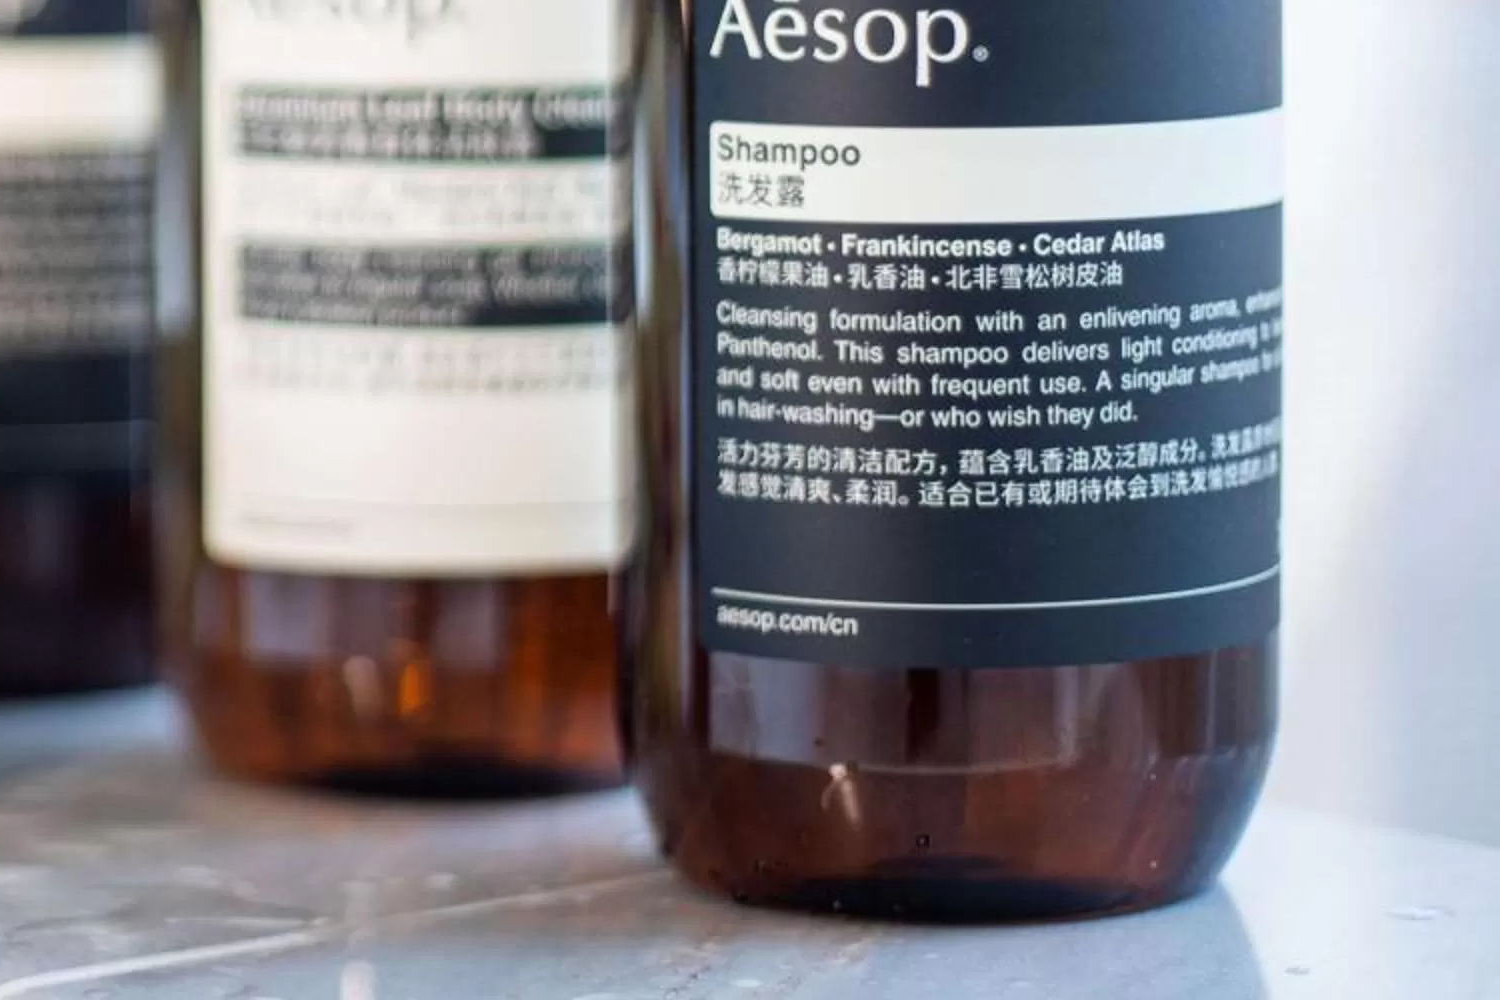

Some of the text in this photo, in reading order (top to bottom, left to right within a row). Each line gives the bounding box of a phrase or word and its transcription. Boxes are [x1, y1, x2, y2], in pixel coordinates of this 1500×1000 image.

[718, 133, 861, 170] Shampoo
[718, 172, 804, 208] 洗发露
[716, 226, 1165, 257] Bergamot Frankincense Cedar Atlas
[716, 300, 817, 334] Cleansing
[830, 308, 961, 333] formulation
[976, 310, 1023, 331] with
[1037, 313, 1067, 331] an
[1080, 304, 1181, 330] enlivening
[717, 331, 823, 361] Panthenol.
[833, 339, 883, 364] This
[897, 342, 1009, 369] shampoo
[1022, 341, 1109, 364] delivers
[1121, 335, 1163, 364] light
[716, 367, 752, 387] and
[760, 368, 799, 392] soft
[807, 374, 863, 394] even
[872, 373, 920, 395] with
[930, 373, 1030, 400] frequent
[1040, 376, 1087, 394] use.
[1095, 370, 1112, 391] A
[1120, 366, 1195, 393] singular
[716, 394, 734, 417] in
[931, 407, 980, 427] who
[987, 405, 1040, 428] wish
[1047, 403, 1094, 430] they
[1100, 400, 1138, 424] did.
[716, 605, 859, 636] aesop.com/cn
